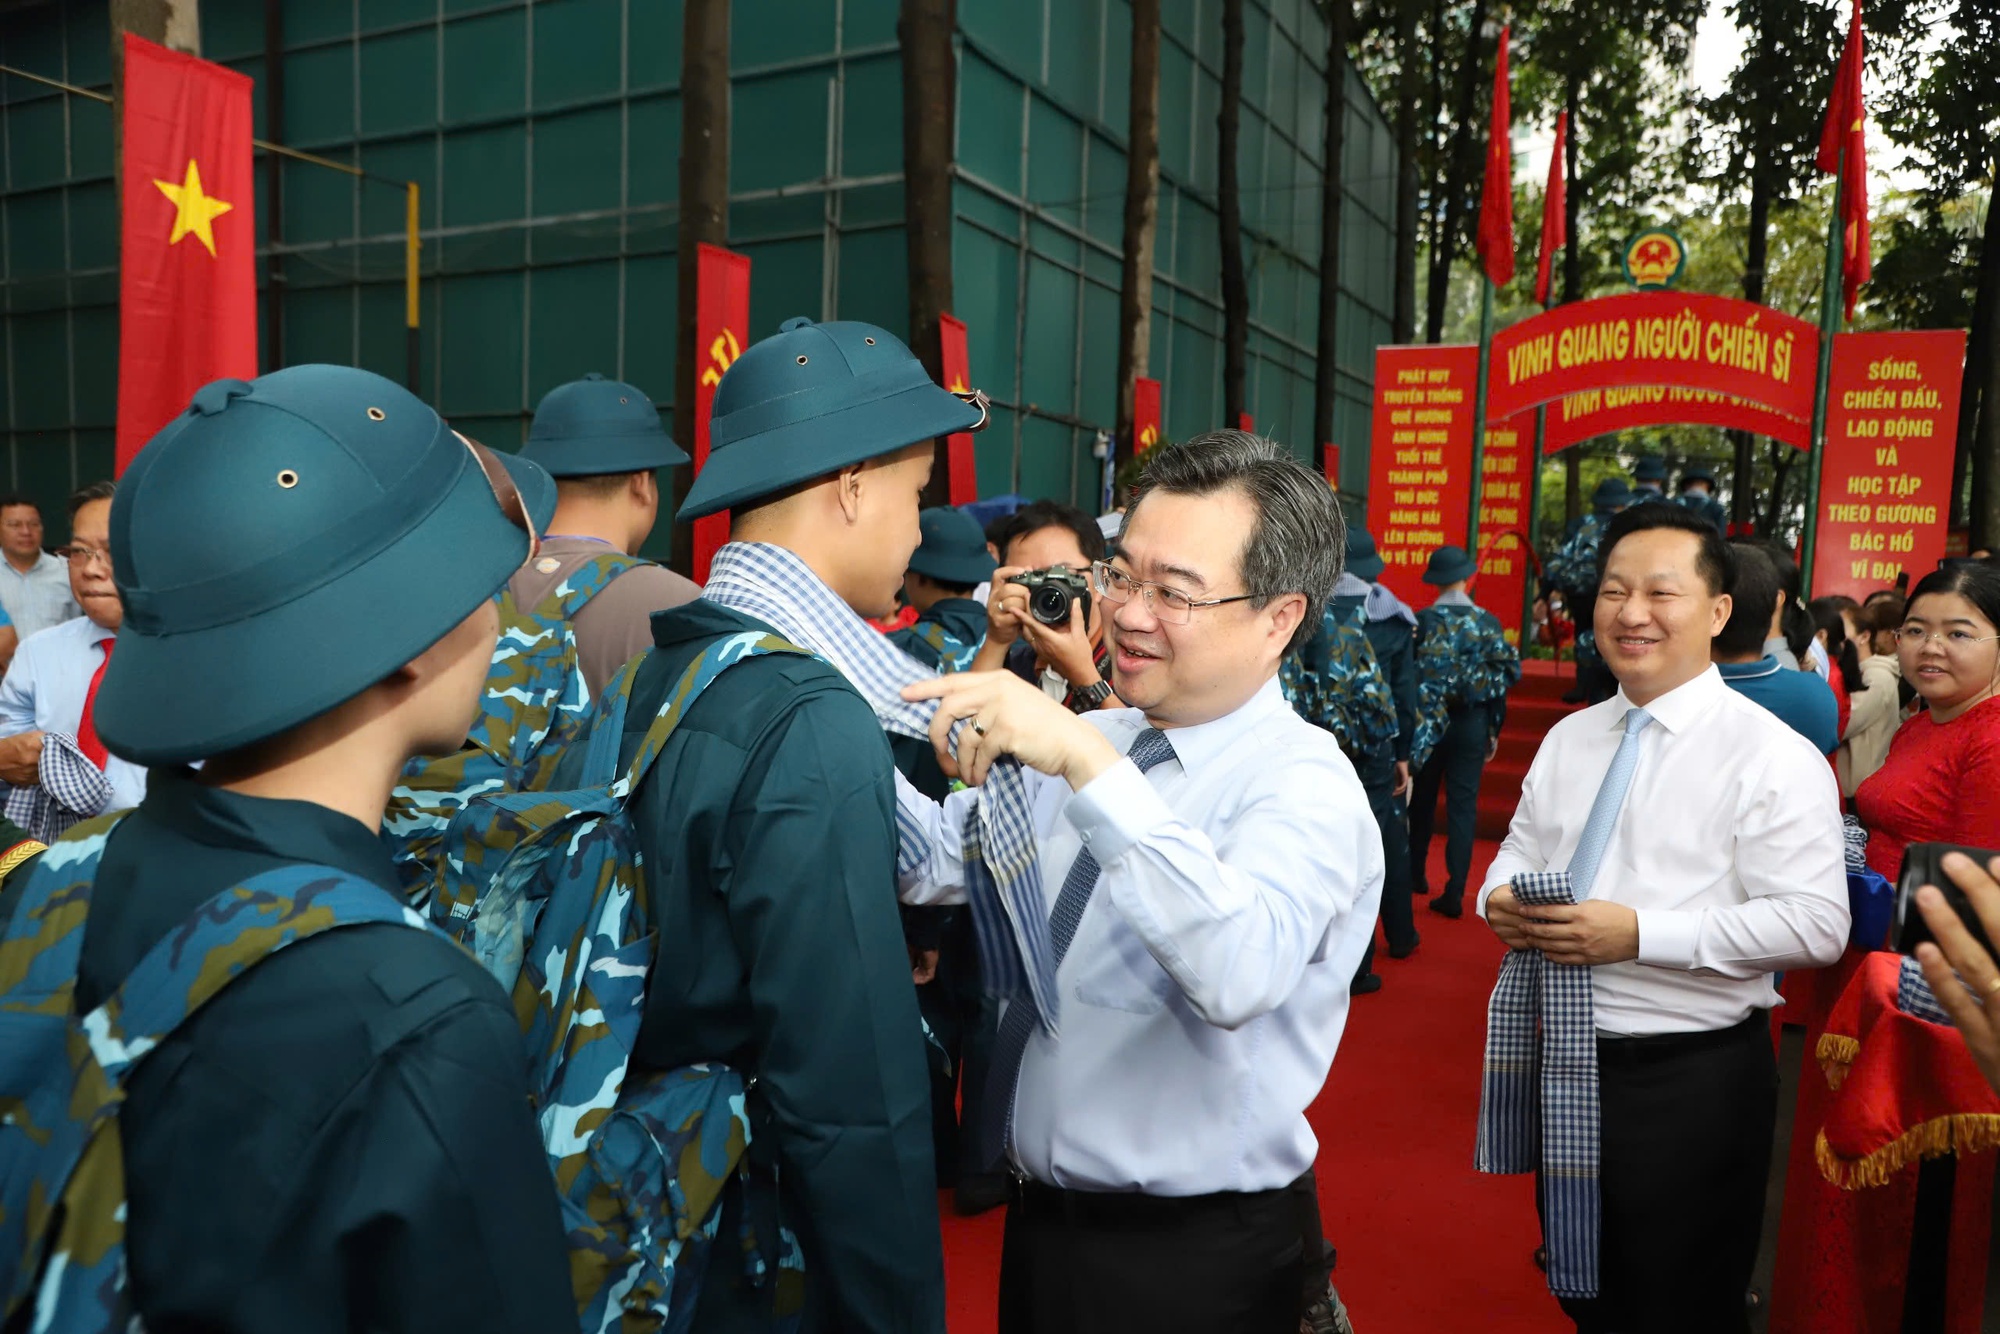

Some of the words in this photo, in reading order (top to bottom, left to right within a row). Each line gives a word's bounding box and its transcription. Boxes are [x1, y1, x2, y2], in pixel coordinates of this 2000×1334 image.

[1508, 334, 1554, 385] VINH
[1558, 319, 1629, 368] QUANG
[1634, 308, 1701, 360] NGƯỜI
[1706, 312, 1768, 374] CHIẾN
[1772, 331, 1794, 383] SĨ
[1868, 355, 1922, 381] SỐNG,
[1843, 385, 1897, 409] CHIẾN
[1901, 384, 1943, 411] ĐẤU,
[1847, 419, 1879, 437] LAO
[1884, 416, 1933, 441] ĐỘNG
[1876, 444, 1898, 466] VÀ
[1847, 477, 1883, 497] HỌC
[1888, 474, 1921, 498] TẬP
[1829, 505, 1871, 522] THEO
[1876, 504, 1936, 524] GƯƠNG
[1384, 529, 1405, 544] LÊN
[1849, 529, 1885, 551] BÁC
[1395, 549, 1408, 567] VỆ
[1851, 559, 1868, 578] VĨ
